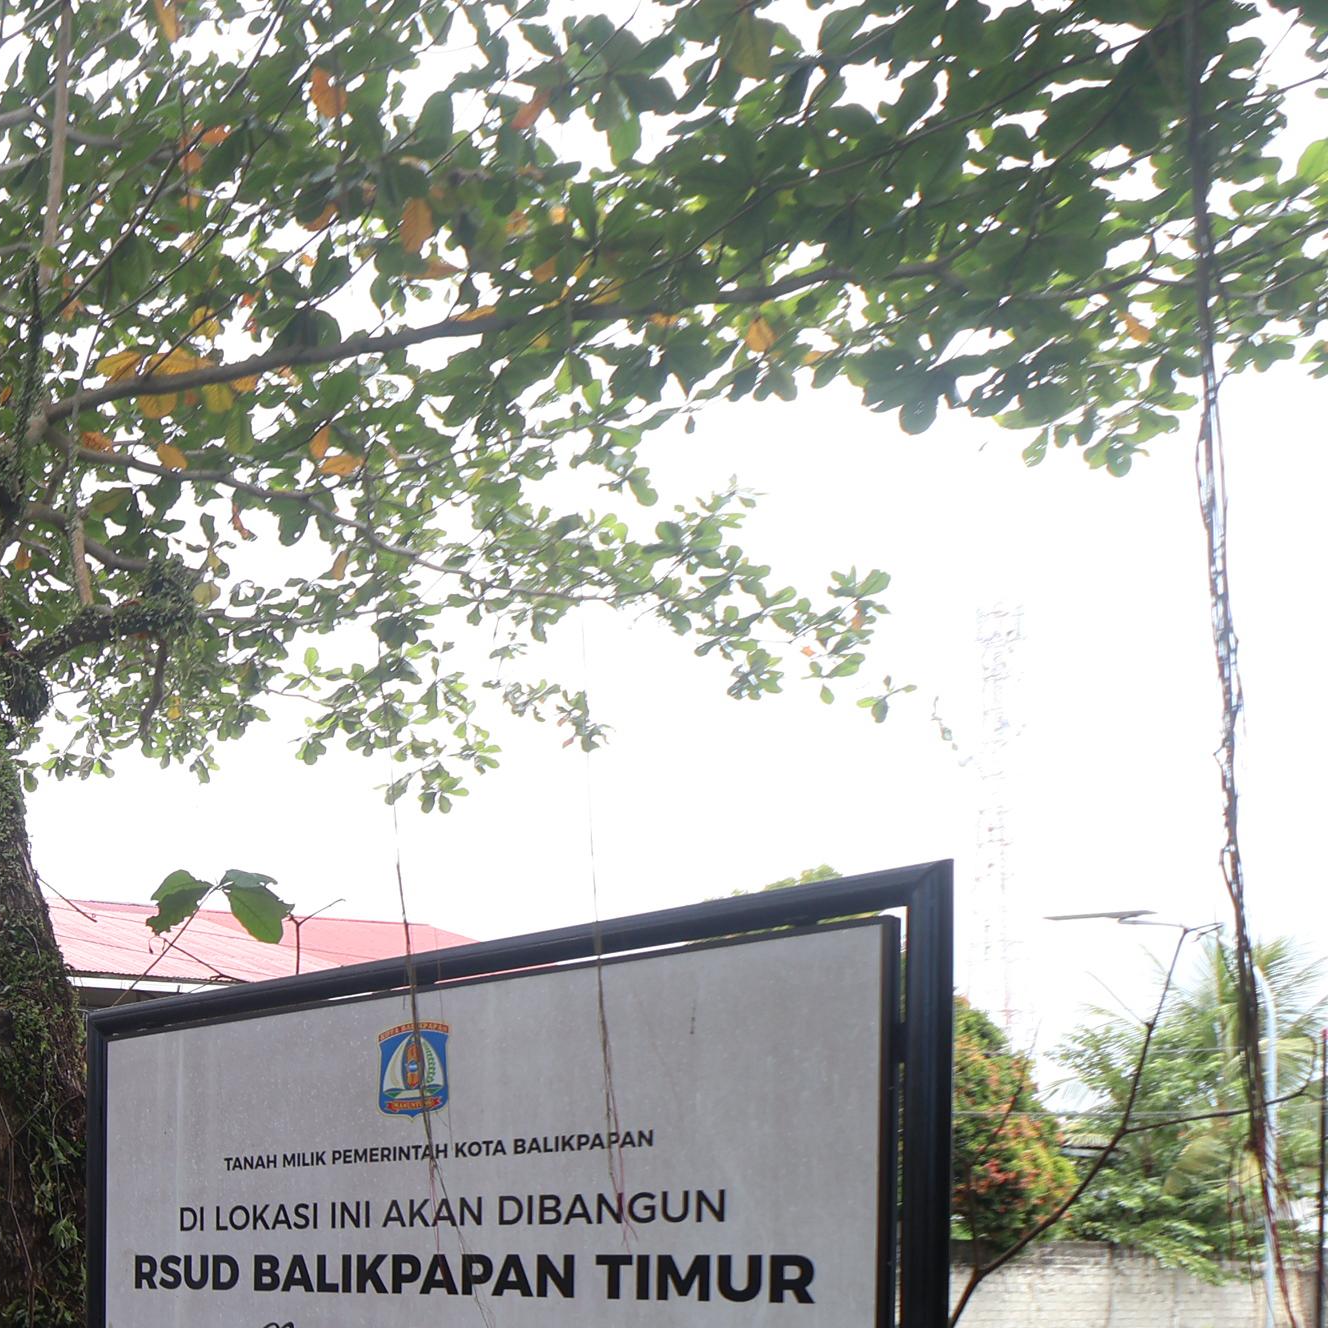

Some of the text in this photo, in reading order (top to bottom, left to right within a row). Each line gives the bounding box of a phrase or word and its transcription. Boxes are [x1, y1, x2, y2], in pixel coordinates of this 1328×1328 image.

[224, 1129, 654, 1172] TANAH MILIK PEMERINTAH KOTA BALIKPAPAN
[179, 1188, 726, 1232] DI LOKASI INI AKAN DIBANGUN
[134, 1253, 815, 1305] RSUD BALIKPAPAN TIMUR
